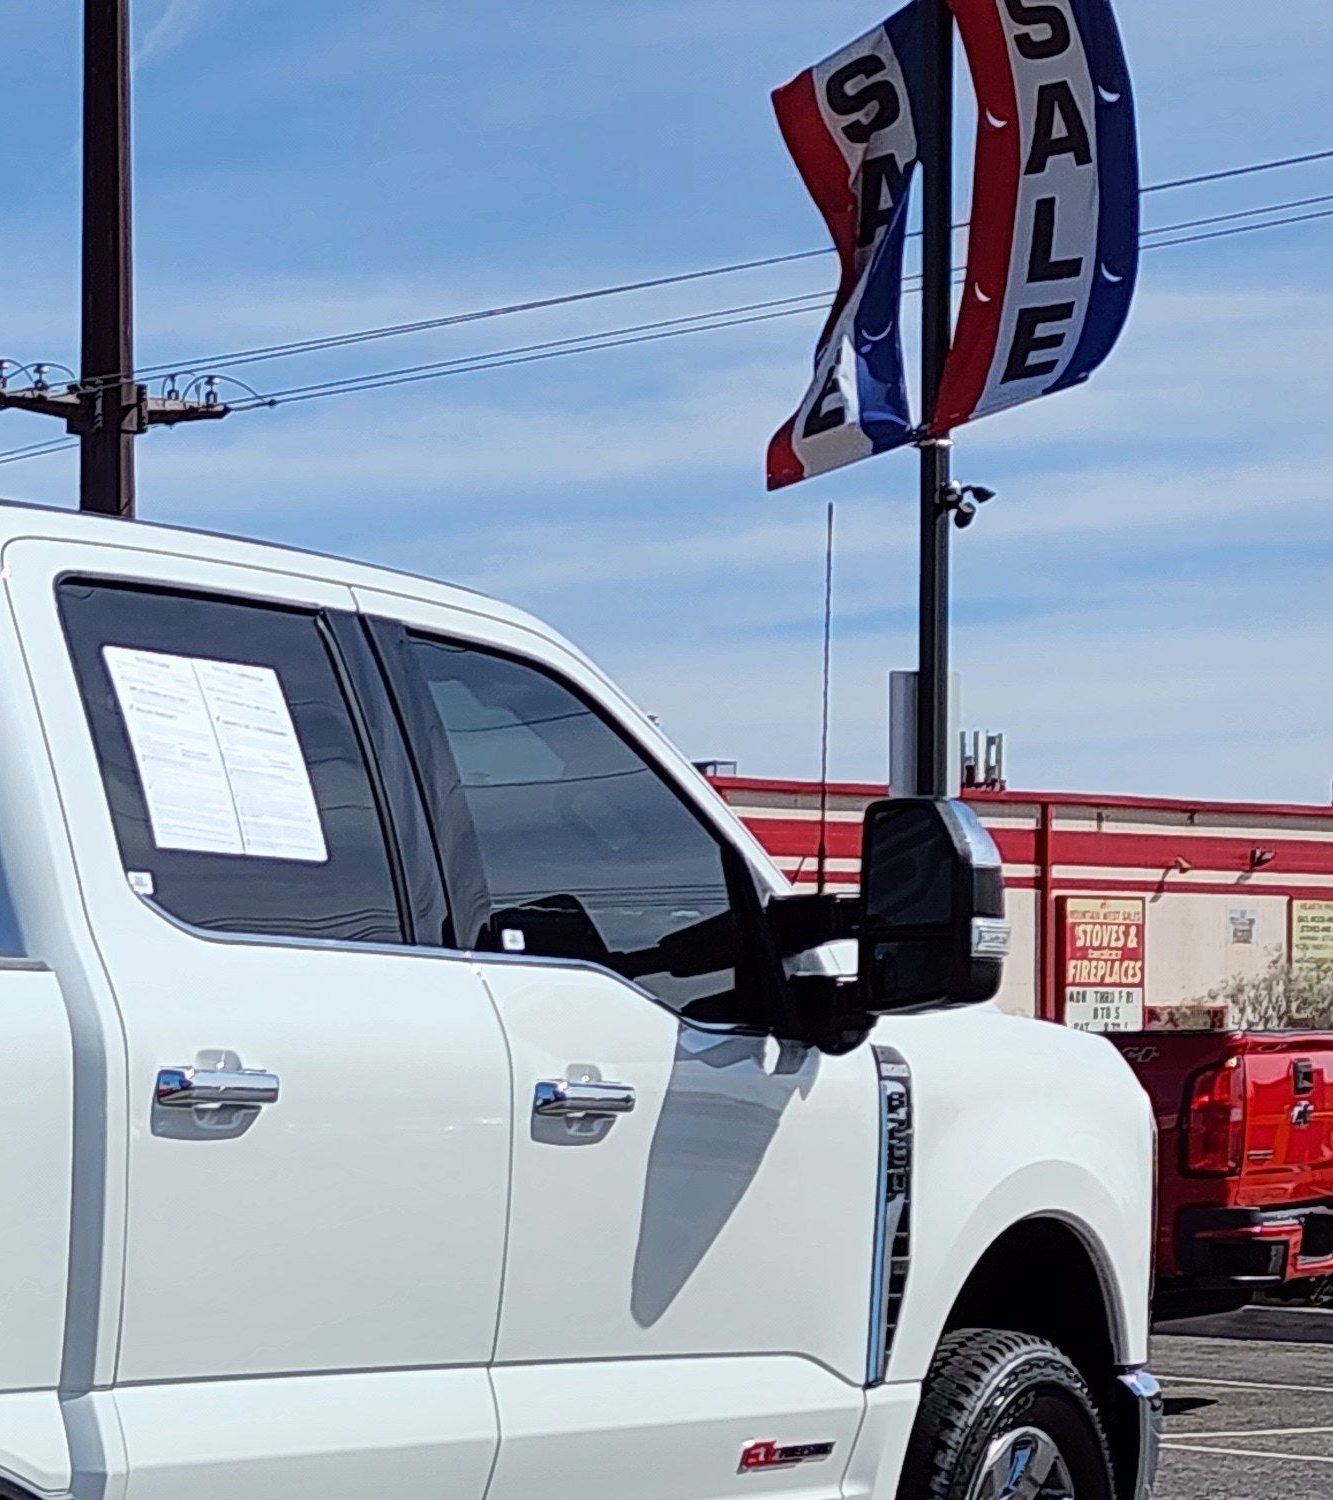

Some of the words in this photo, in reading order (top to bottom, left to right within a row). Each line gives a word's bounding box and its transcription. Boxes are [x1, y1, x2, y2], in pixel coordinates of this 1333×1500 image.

[1001, 0, 1093, 386] SALE
[1075, 924, 1126, 947] STOVES
[1127, 925, 1139, 948] &
[1066, 960, 1142, 984] FIREPLACES
